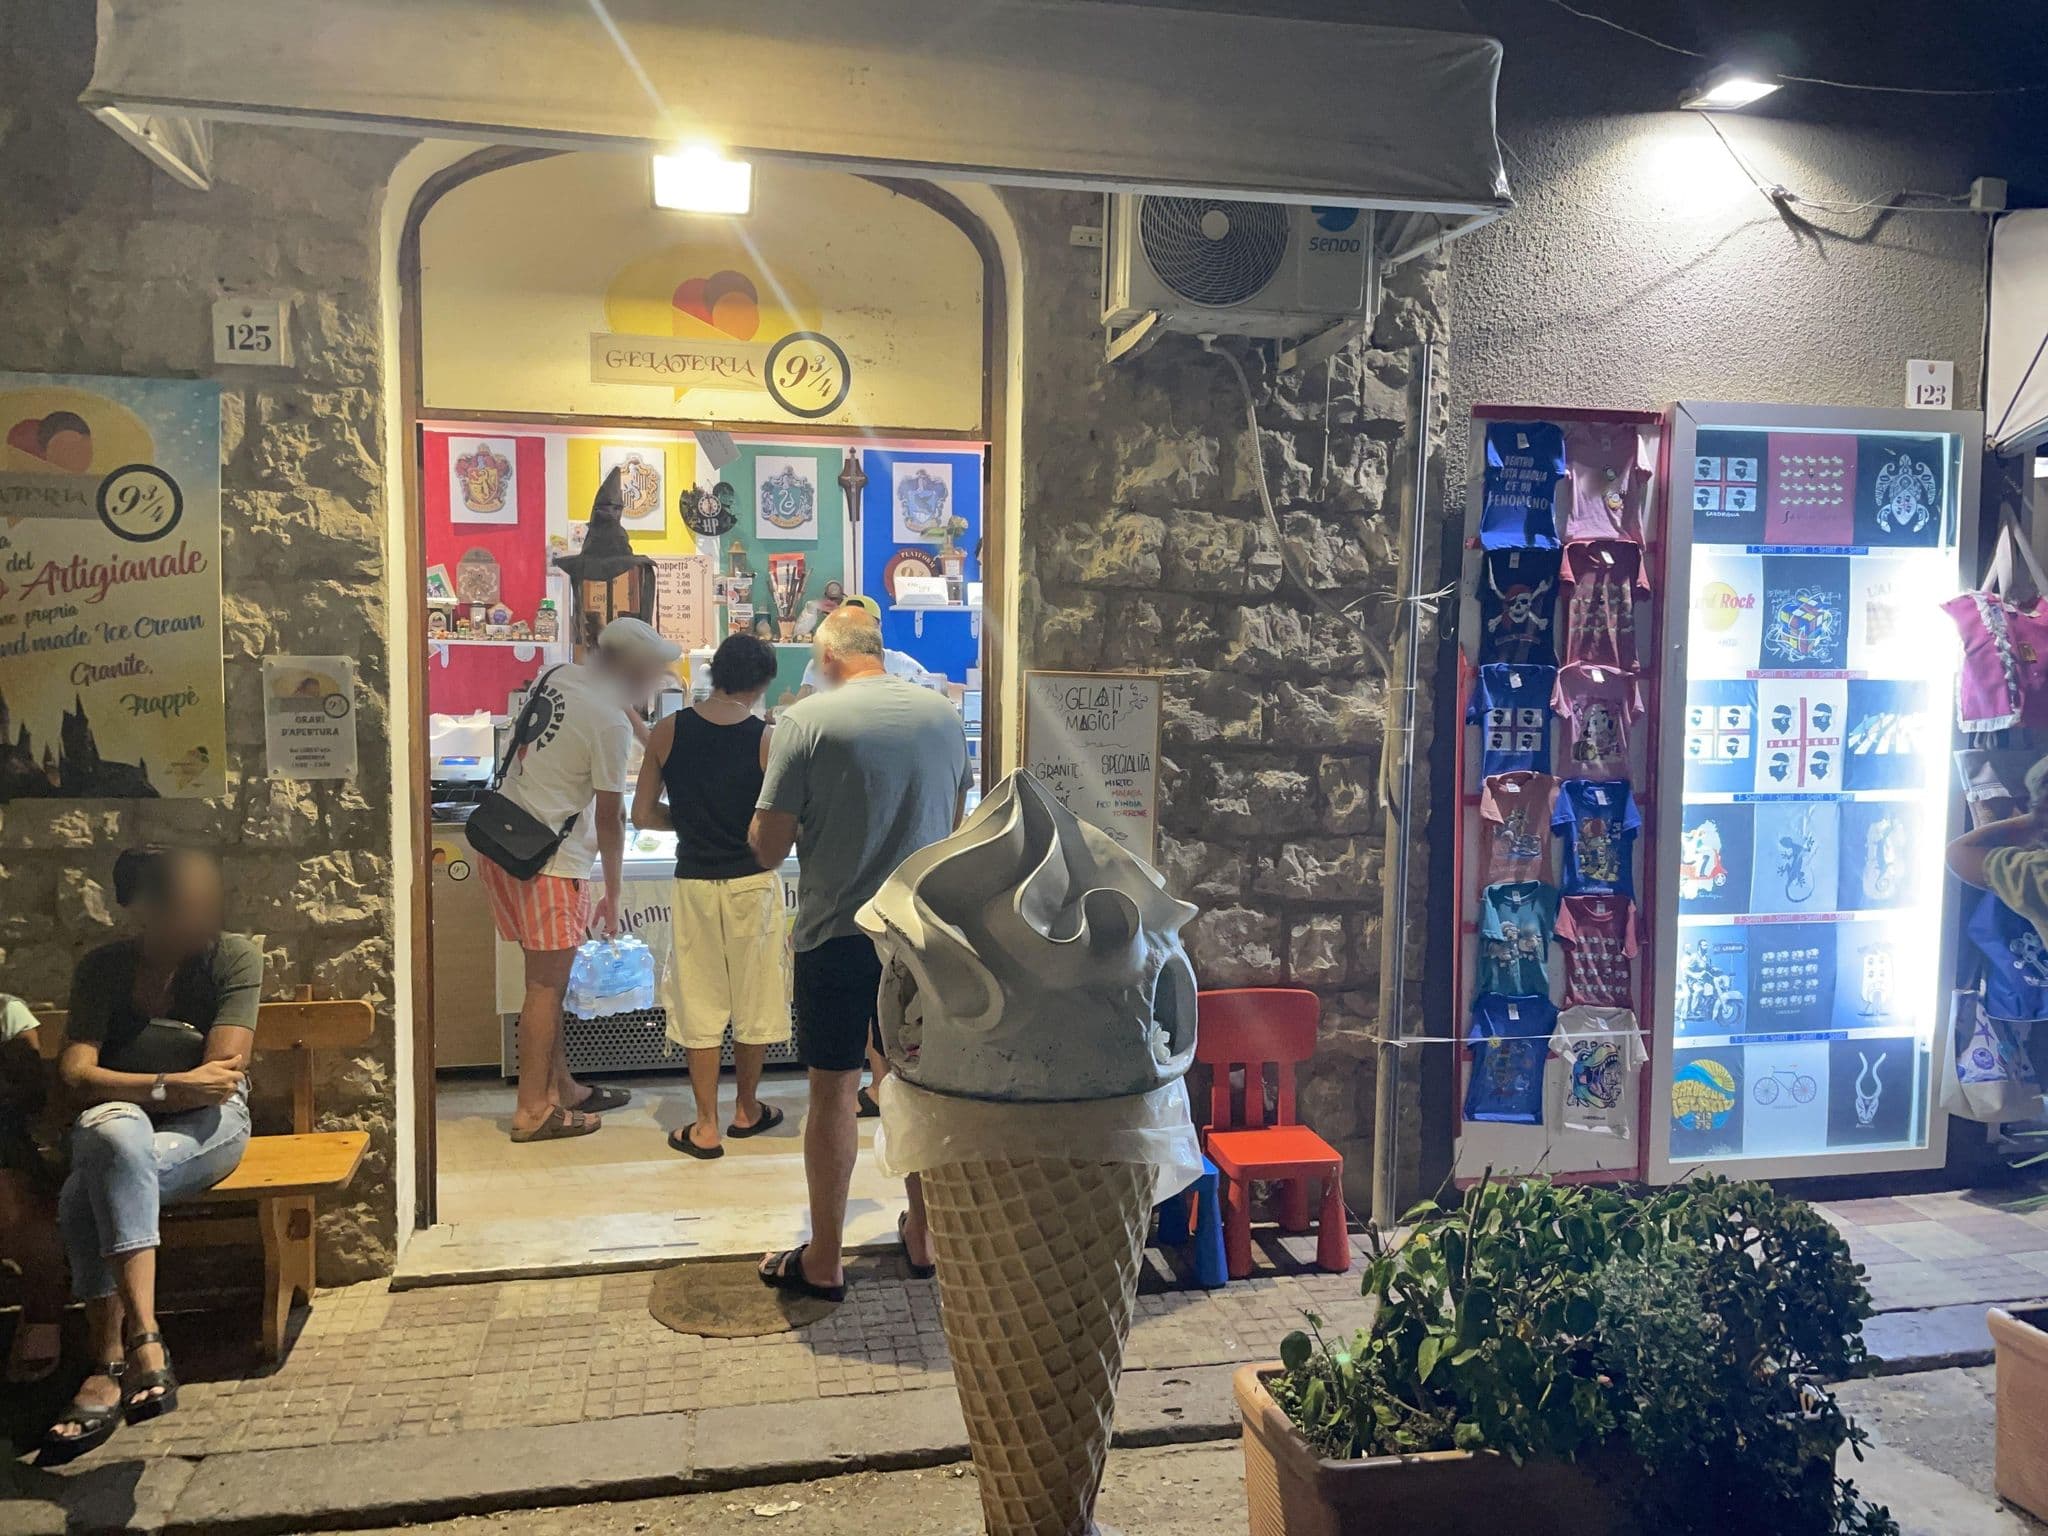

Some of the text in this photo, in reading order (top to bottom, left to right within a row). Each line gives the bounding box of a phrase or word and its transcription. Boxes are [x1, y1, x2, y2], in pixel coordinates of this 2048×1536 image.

[225, 323, 272, 352] 125
[605, 350, 757, 378] GELATERIA
[1915, 384, 1946, 406] 123
[703, 519, 719, 536] HP
[6, 551, 35, 572] del
[901, 551, 936, 569] PLATFORM
[20, 540, 208, 603] Artigianale
[1720, 593, 1757, 609] Rock
[25, 603, 79, 628] propria
[32, 624, 91, 651] made
[95, 621, 133, 643] Ice
[134, 614, 205, 639] Cream
[1065, 686, 1123, 710] GELATI
[295, 715, 325, 724] ORARI
[1065, 711, 1119, 731] MAGICI
[1054, 780, 1065, 791] &
[1104, 779, 1134, 788] MIRTO
